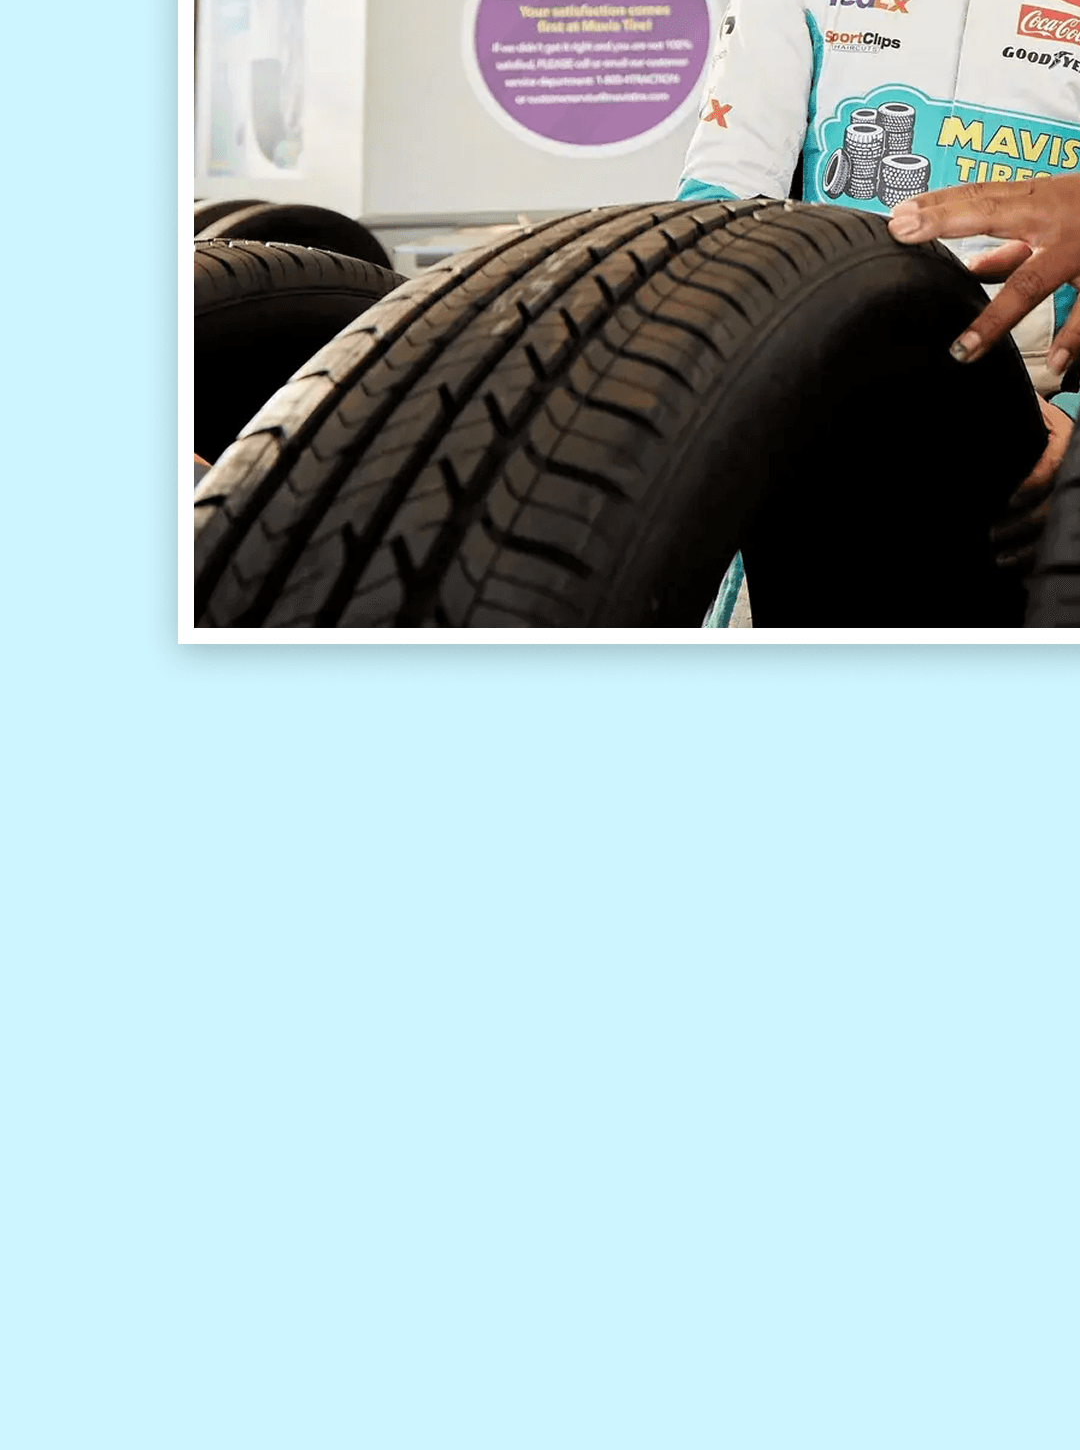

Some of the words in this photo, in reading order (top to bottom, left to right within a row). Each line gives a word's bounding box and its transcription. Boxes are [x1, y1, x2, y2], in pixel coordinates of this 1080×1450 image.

[550, 4, 626, 18] satisfaction
[581, 19, 621, 32] Mavis
[956, 156, 1053, 183] TIRE
